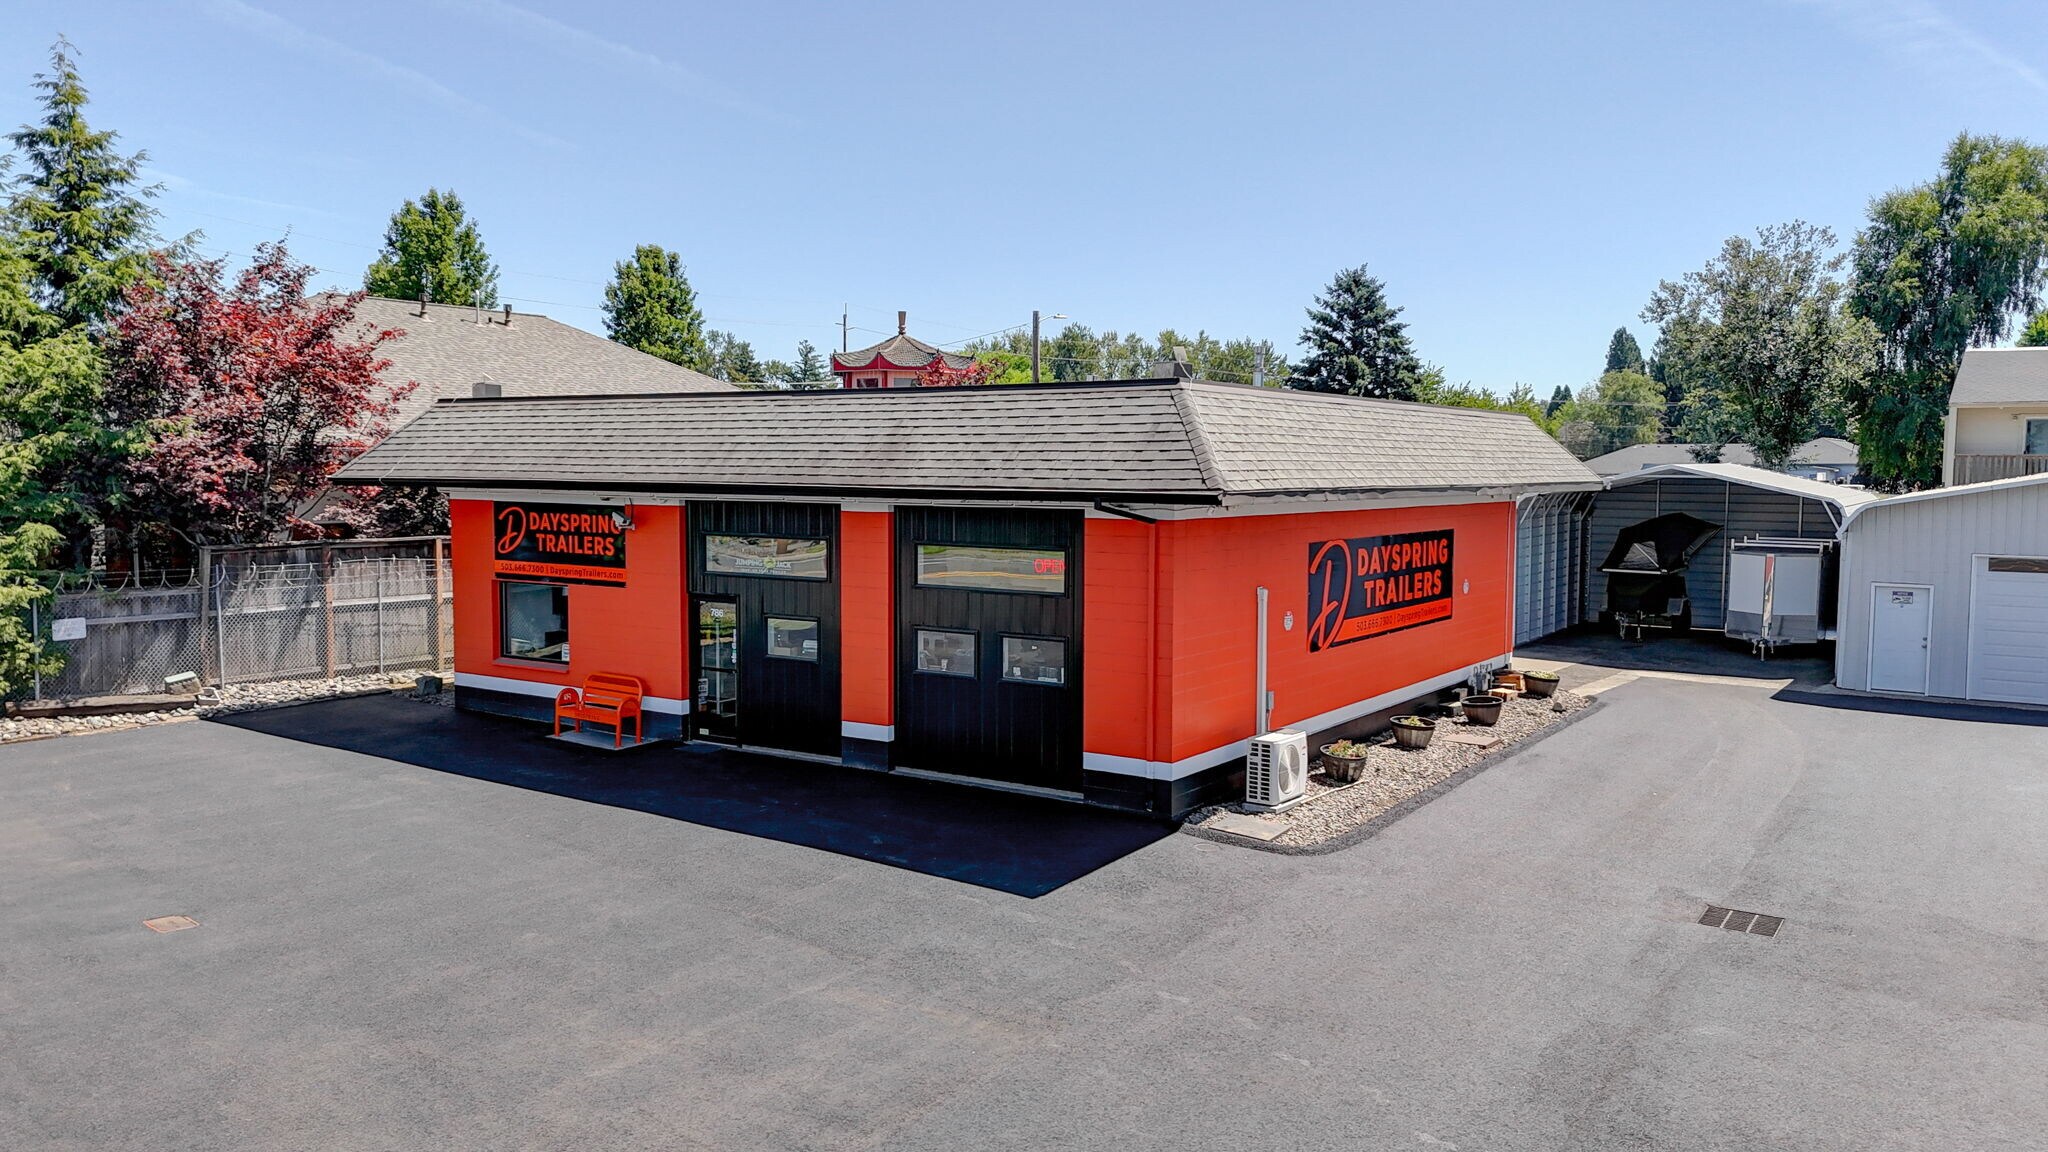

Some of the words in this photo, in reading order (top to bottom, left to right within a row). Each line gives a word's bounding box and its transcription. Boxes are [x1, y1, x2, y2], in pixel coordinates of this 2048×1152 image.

[536, 533, 615, 556] TRAILERS
[1034, 558, 1065, 574] OPEN
[1357, 538, 1448, 576] DAYSPRING
[549, 566, 624, 579] DayspringTrailers.com
[1364, 569, 1442, 609] TRAILERS
